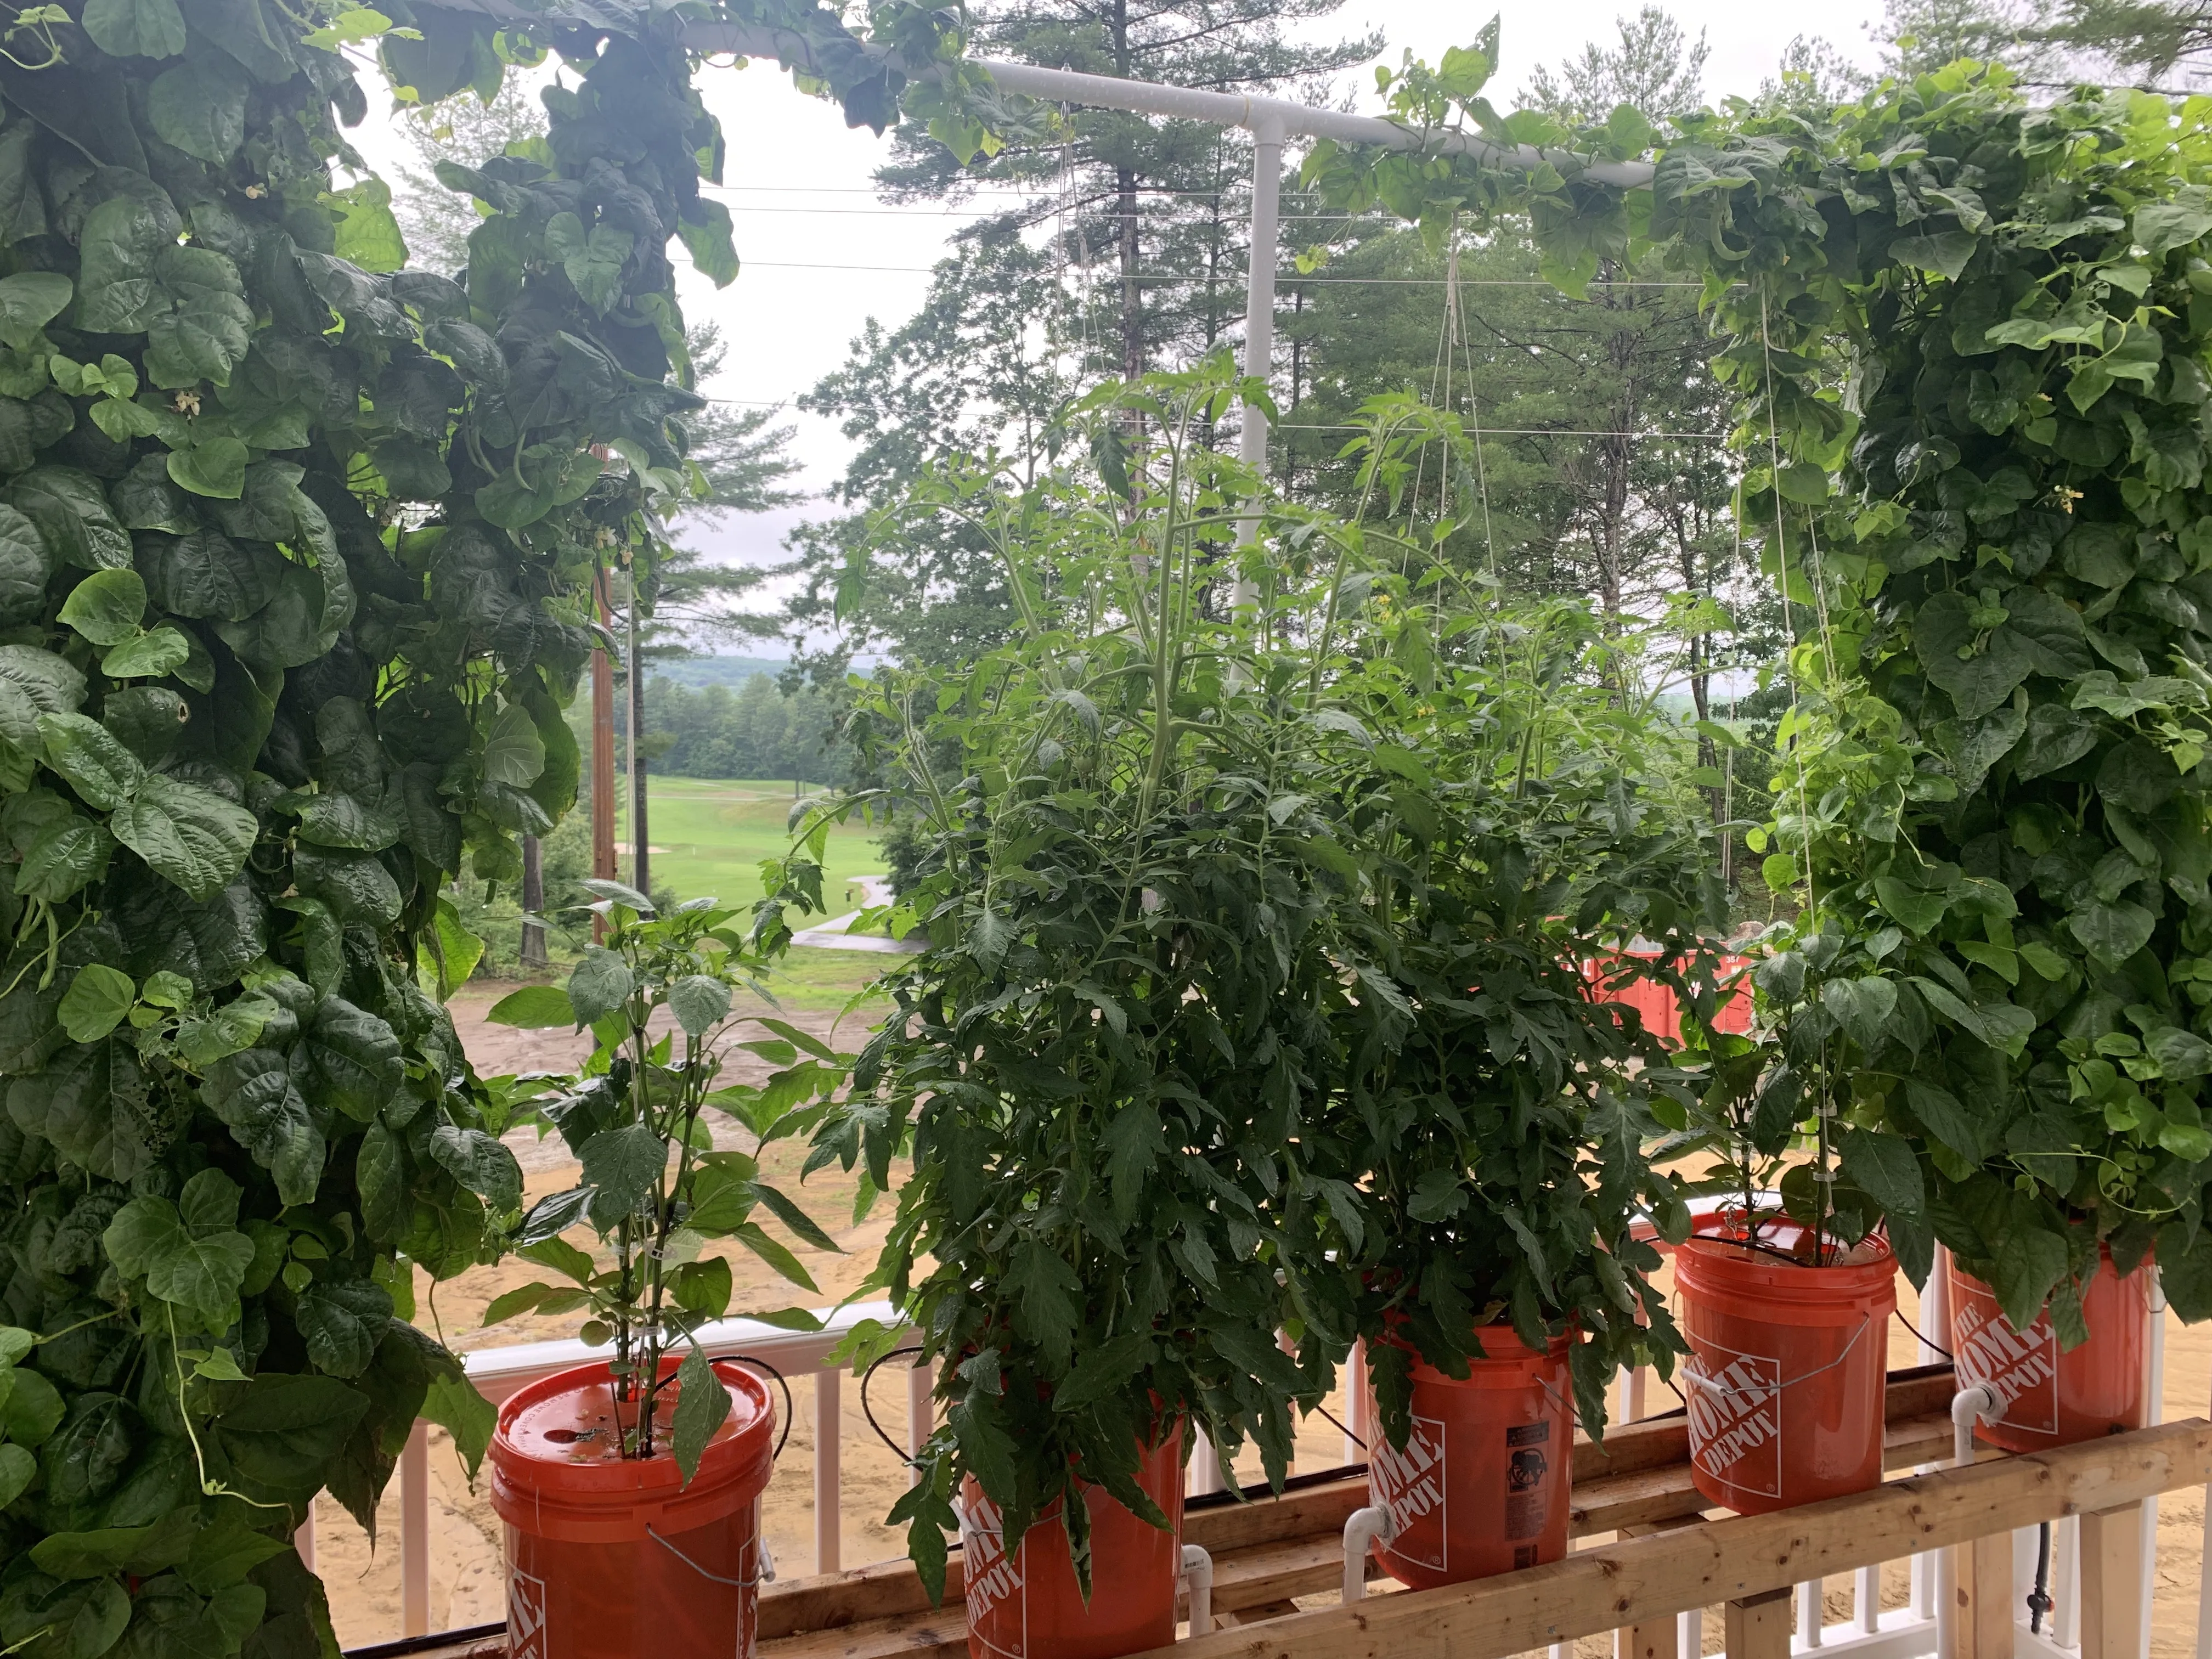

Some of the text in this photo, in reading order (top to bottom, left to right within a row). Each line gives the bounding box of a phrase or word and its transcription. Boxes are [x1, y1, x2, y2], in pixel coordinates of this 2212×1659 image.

[1369, 1416, 1443, 1508] OME
[1703, 1409, 1778, 1476] DEPOT
[1393, 1475, 1443, 1538] EPOT
